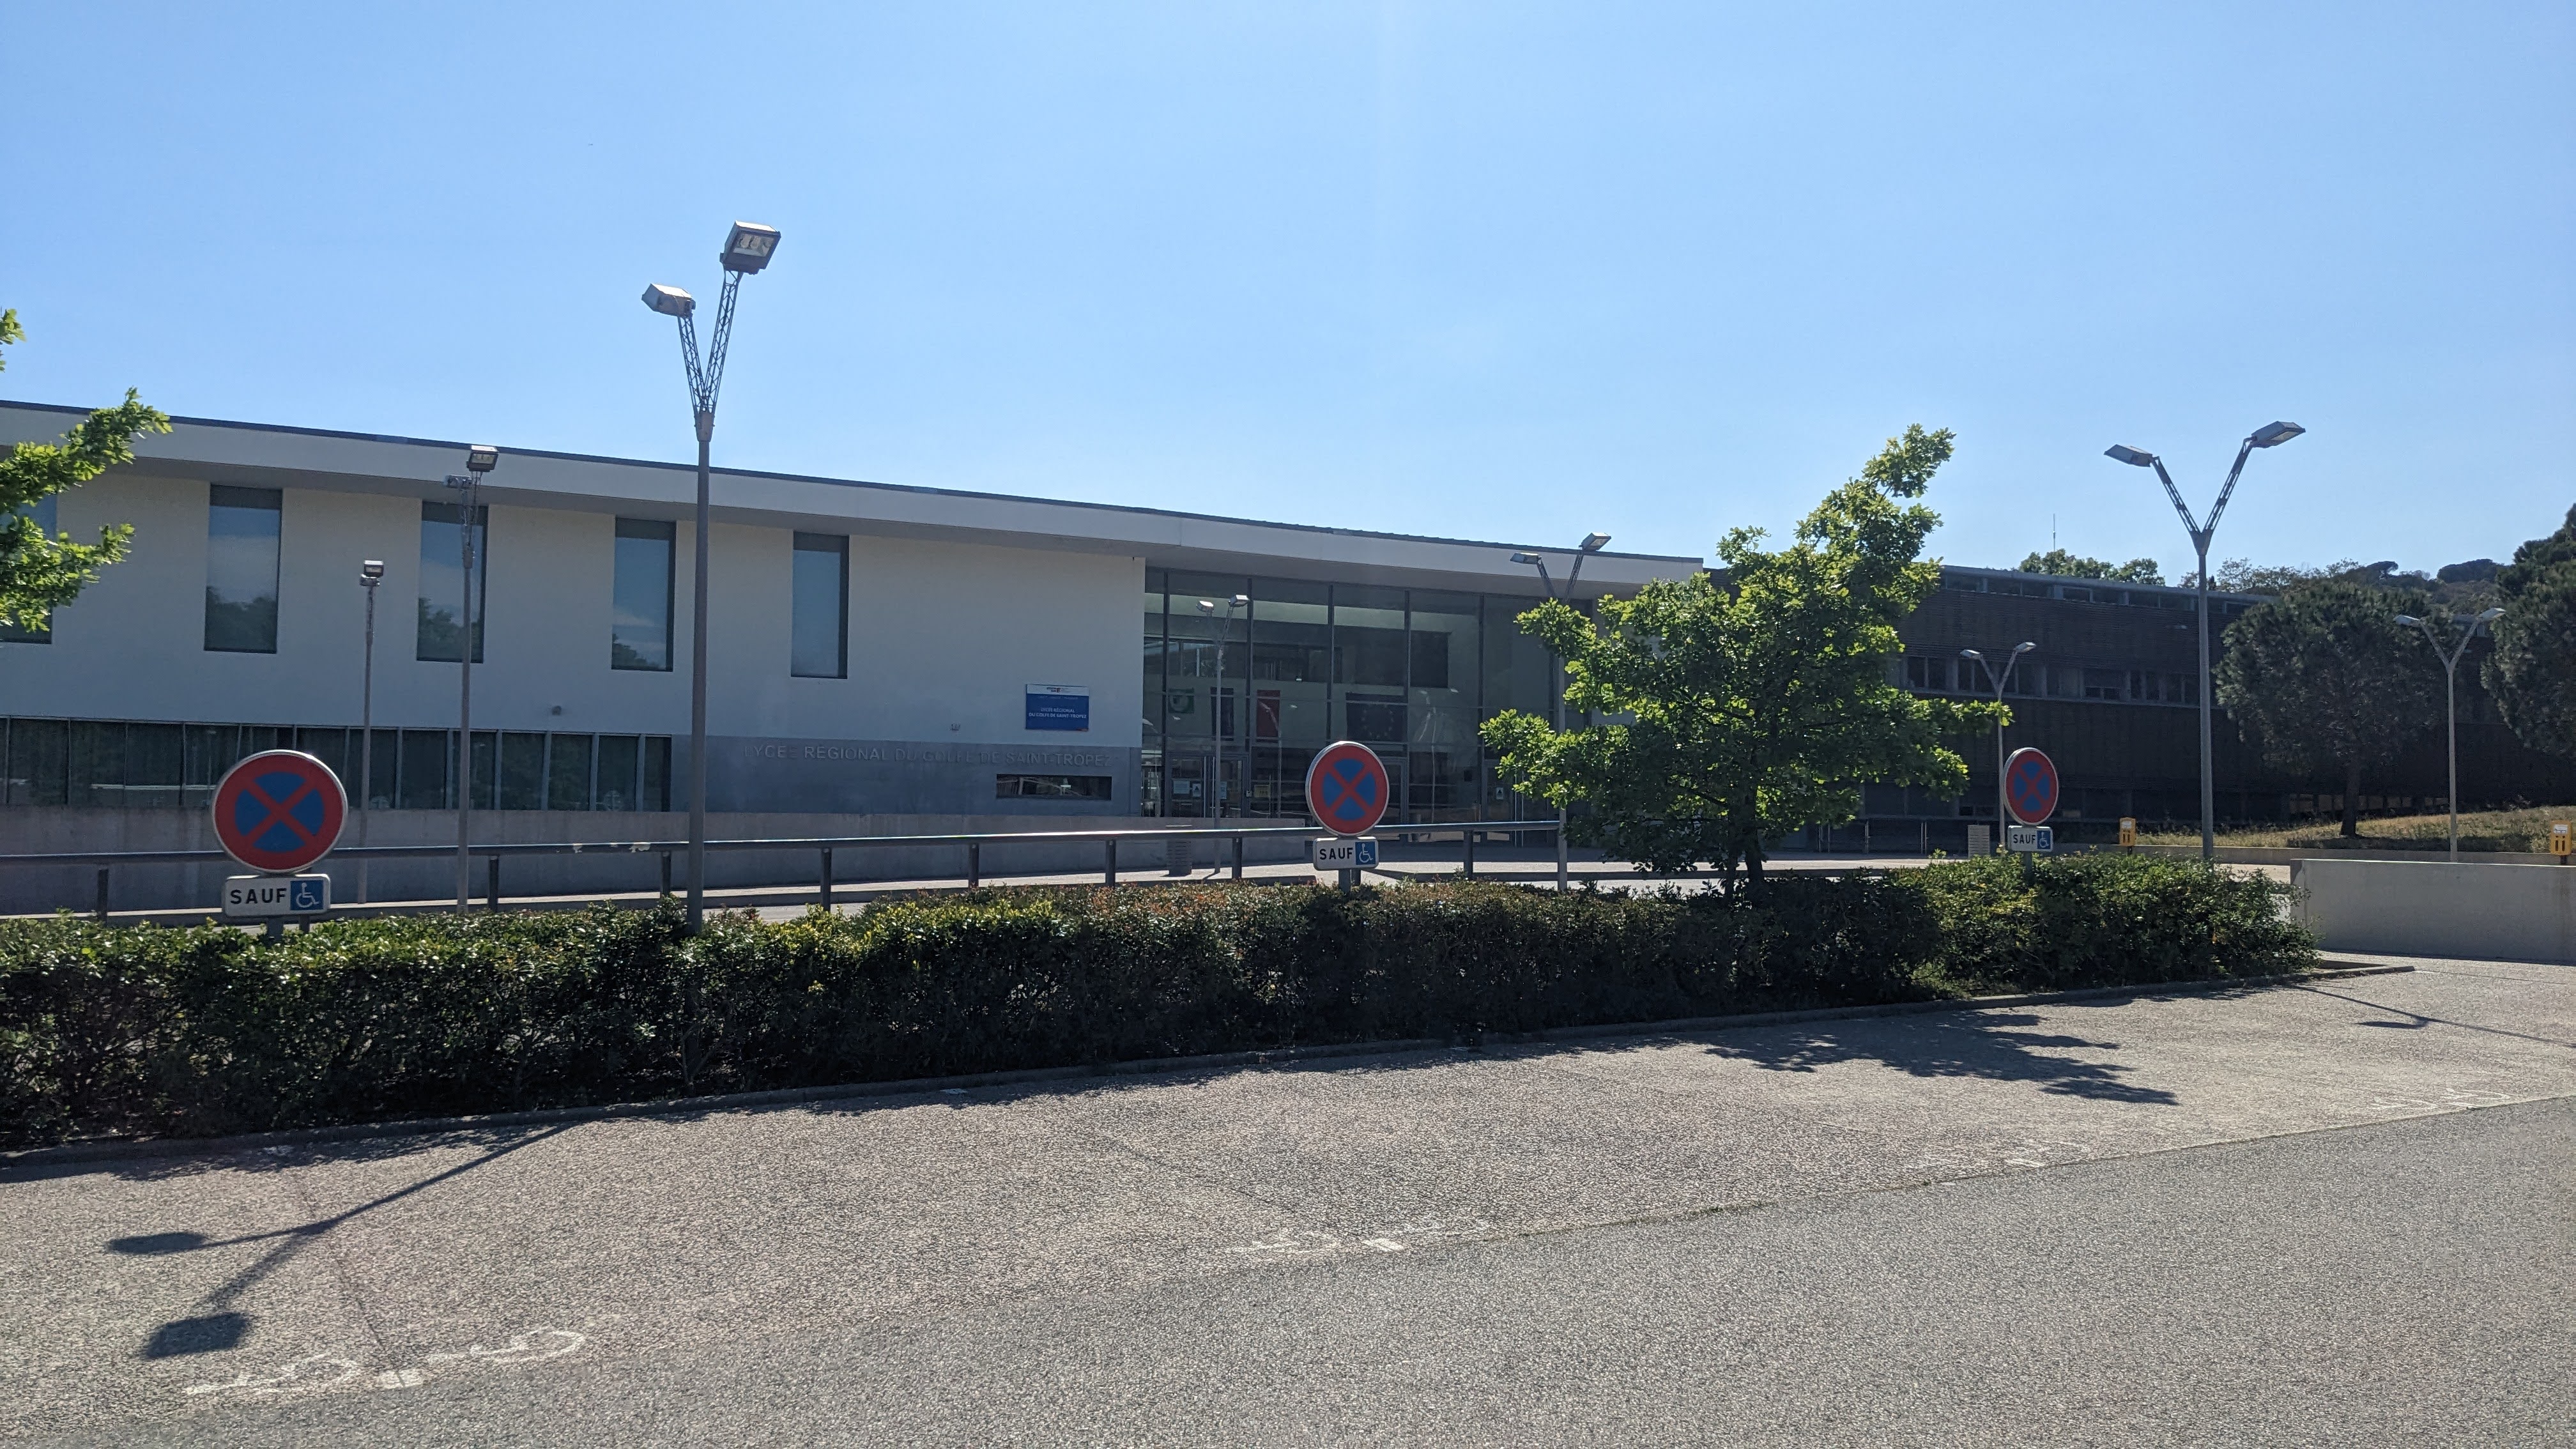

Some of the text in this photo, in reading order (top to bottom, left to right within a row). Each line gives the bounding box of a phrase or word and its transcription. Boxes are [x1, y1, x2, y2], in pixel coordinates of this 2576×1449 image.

[980, 751, 1001, 765] DE
[2013, 834, 2036, 844] SAUF
[1319, 847, 1353, 860] SAUF
[230, 887, 287, 905] SAUF
